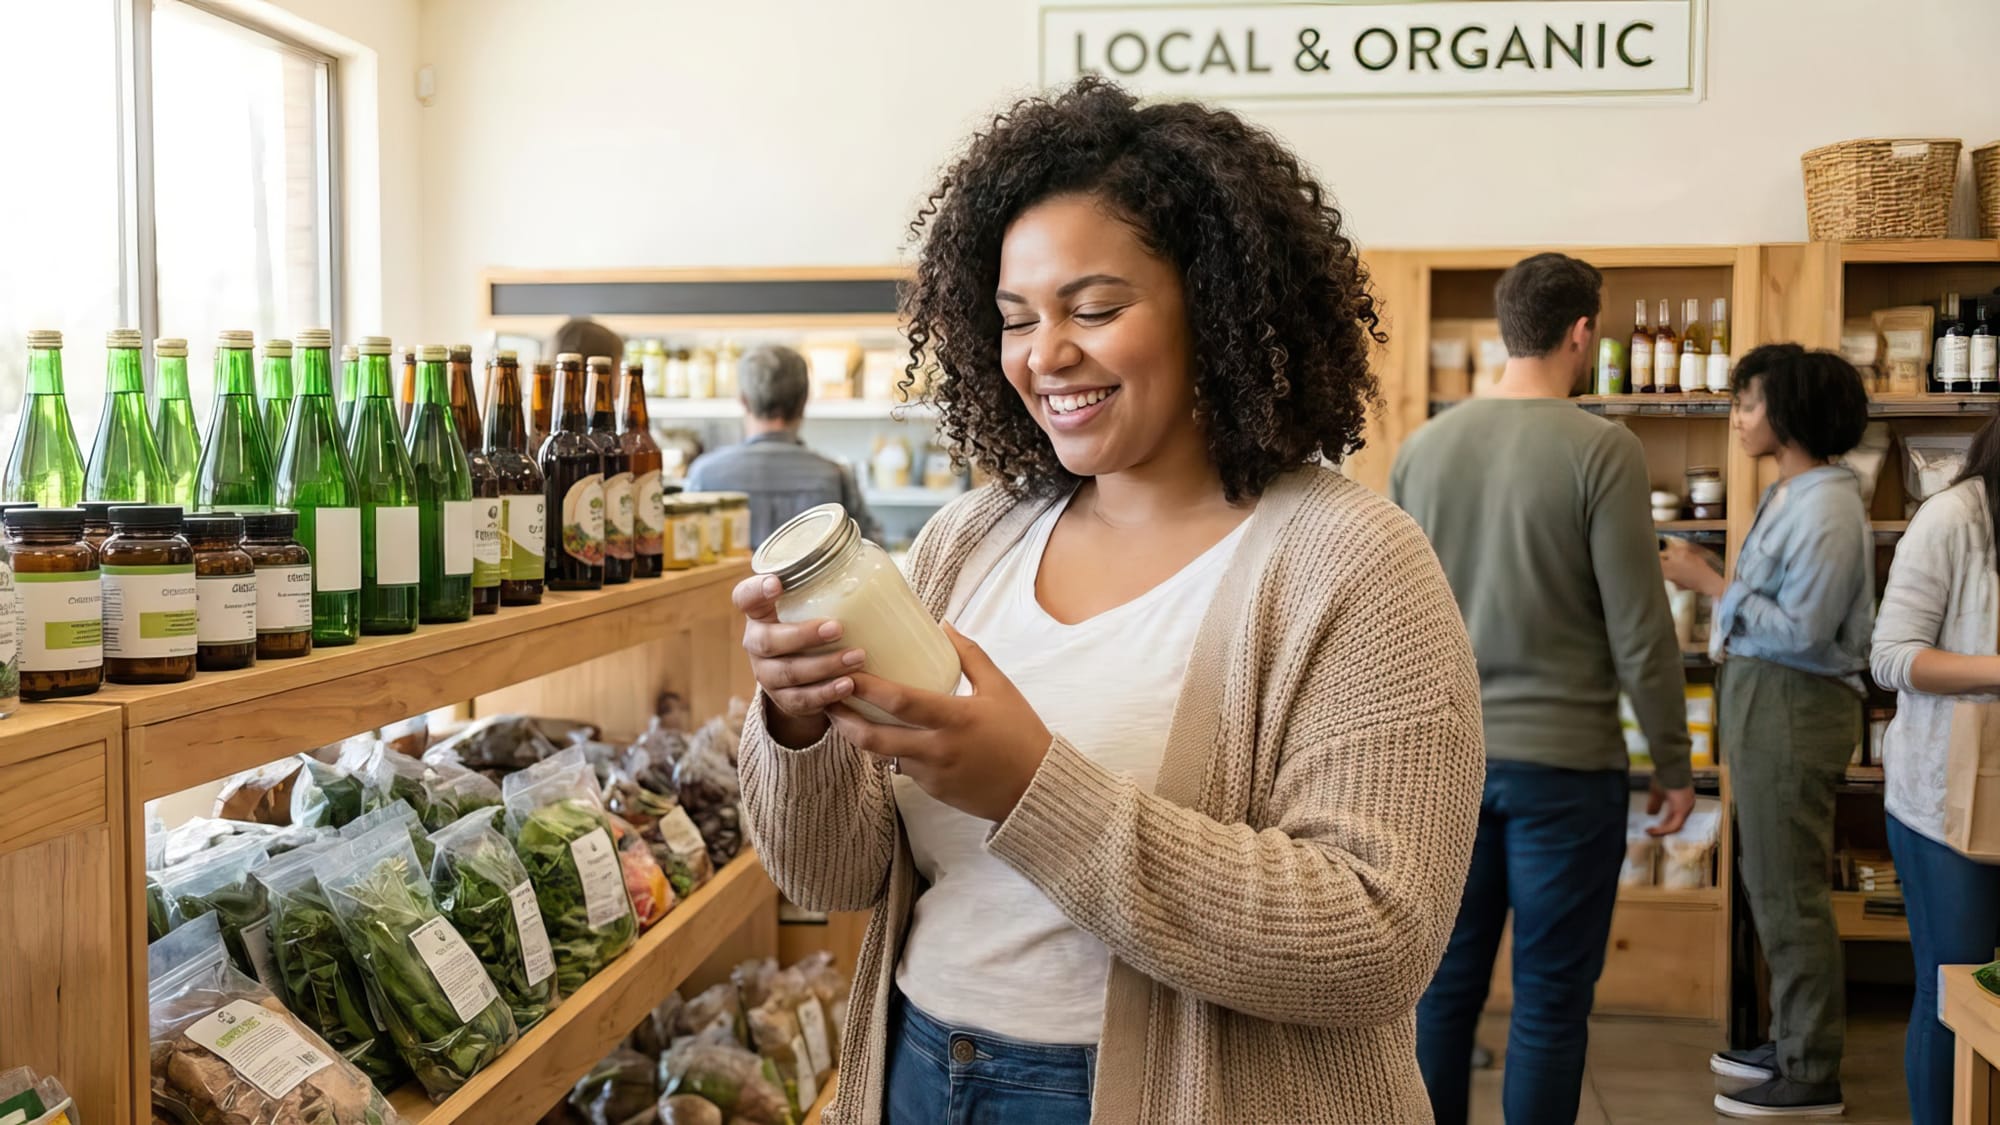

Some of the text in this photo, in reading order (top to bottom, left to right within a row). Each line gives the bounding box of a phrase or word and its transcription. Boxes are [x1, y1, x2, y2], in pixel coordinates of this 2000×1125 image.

[1075, 21, 1656, 76] LOCAL & ORGANIC
